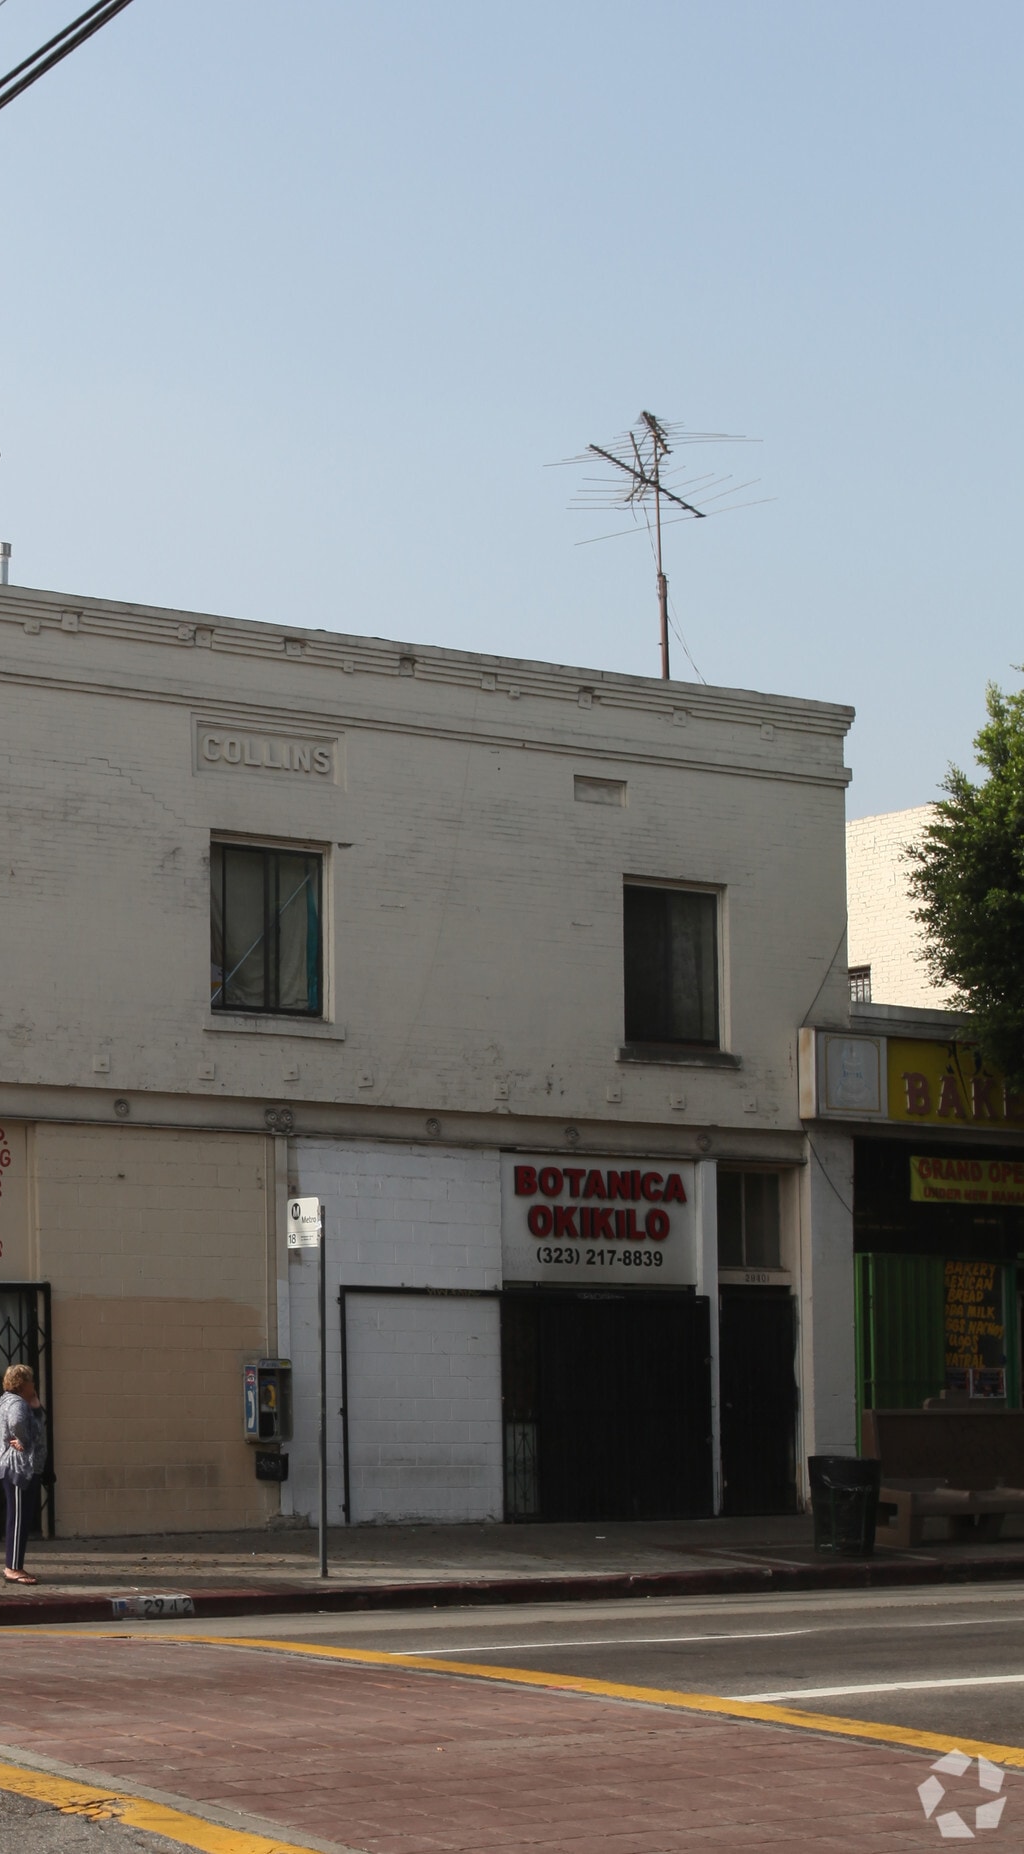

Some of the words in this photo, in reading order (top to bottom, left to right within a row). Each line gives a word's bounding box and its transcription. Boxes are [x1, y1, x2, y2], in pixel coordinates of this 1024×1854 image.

[203, 734, 331, 774] COLLINS
[918, 1158, 983, 1182] GRAND
[514, 1165, 687, 1203] BOTANICA
[923, 1186, 961, 1200] UNDER
[964, 1190, 988, 1201] NEW
[301, 1215, 317, 1224] Metro
[528, 1205, 670, 1241] OKIKILO
[288, 1233, 297, 1244] 18
[537, 1246, 580, 1264] (323)
[586, 1249, 663, 1267] 217-8839
[946, 1287, 984, 1303] BREAD
